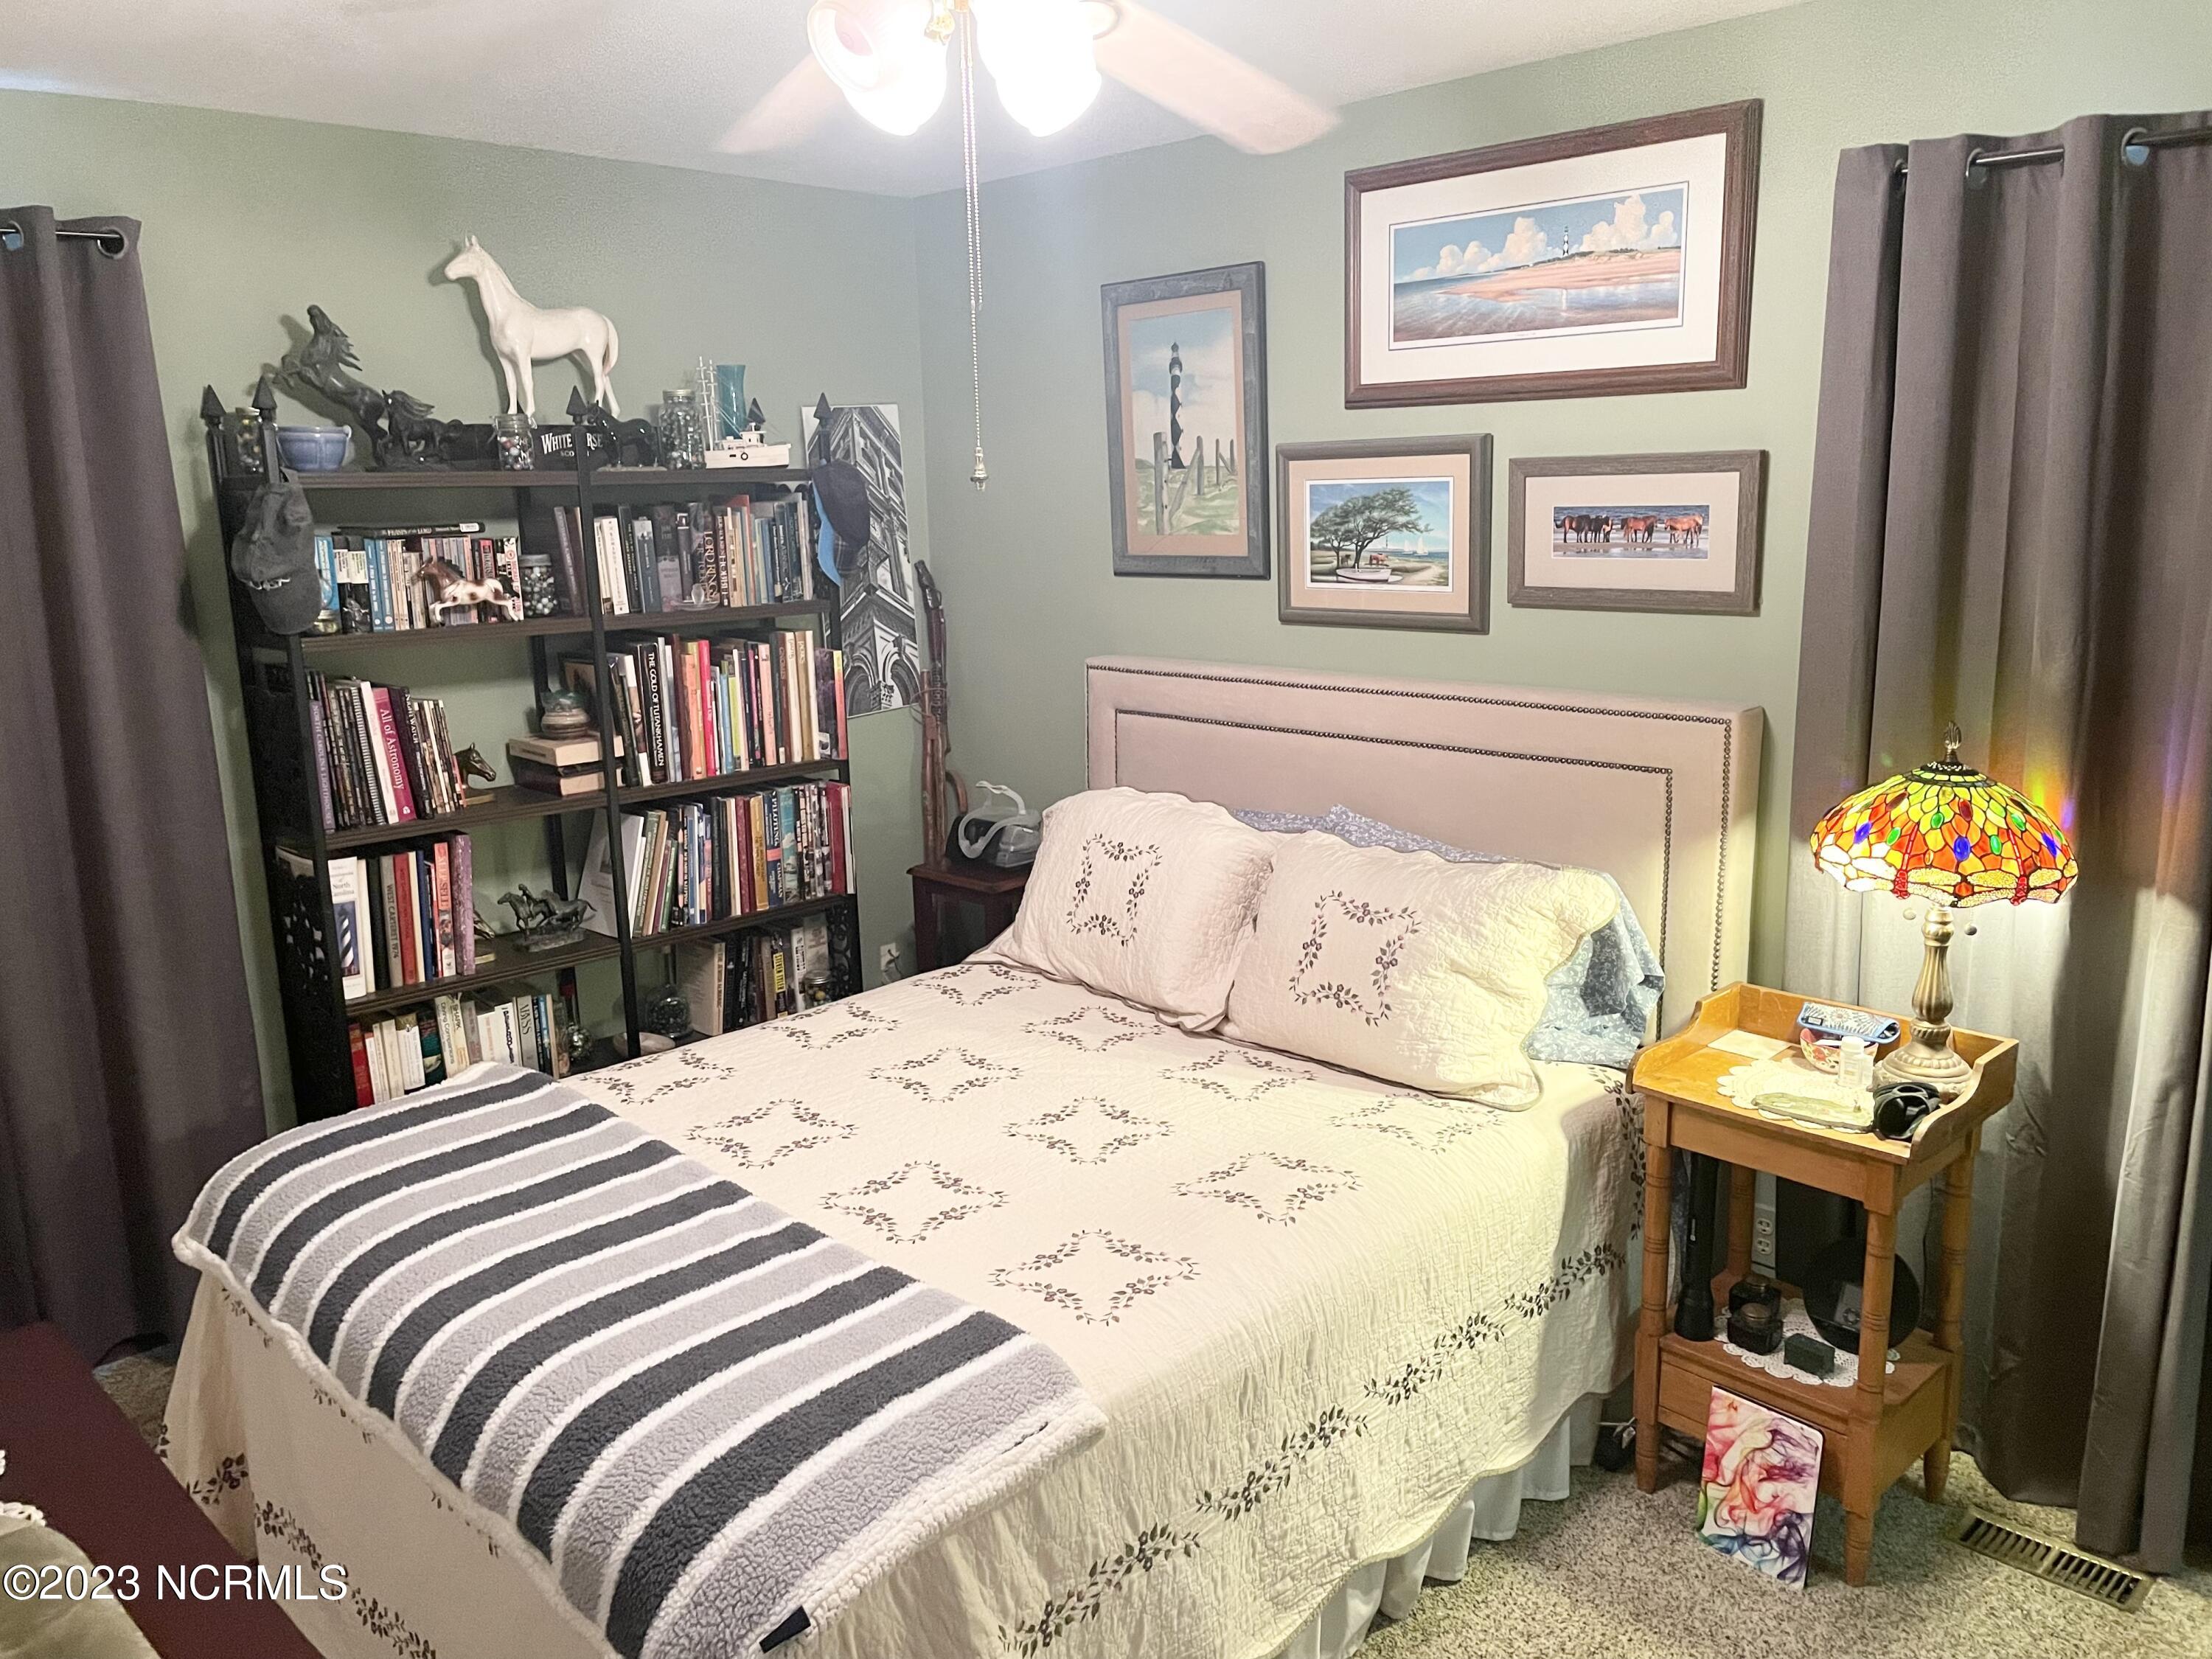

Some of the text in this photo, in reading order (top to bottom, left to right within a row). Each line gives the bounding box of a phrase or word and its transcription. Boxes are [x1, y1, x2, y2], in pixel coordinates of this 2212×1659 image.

[540, 433, 572, 455] WHITE
[704, 531, 718, 597] LORD RINGS
[650, 669, 658, 692] GOLD
[652, 693, 659, 703] OF
[313, 705, 323, 732] NORTH
[316, 734, 327, 772] CAROLINA
[380, 709, 405, 790] All of Astronomy
[320, 773, 333, 824] LIGHTHOUSES
[386, 884, 394, 903] WEST
[388, 906, 397, 942] CARTERET
[518, 1003, 532, 1035] ABYSS
